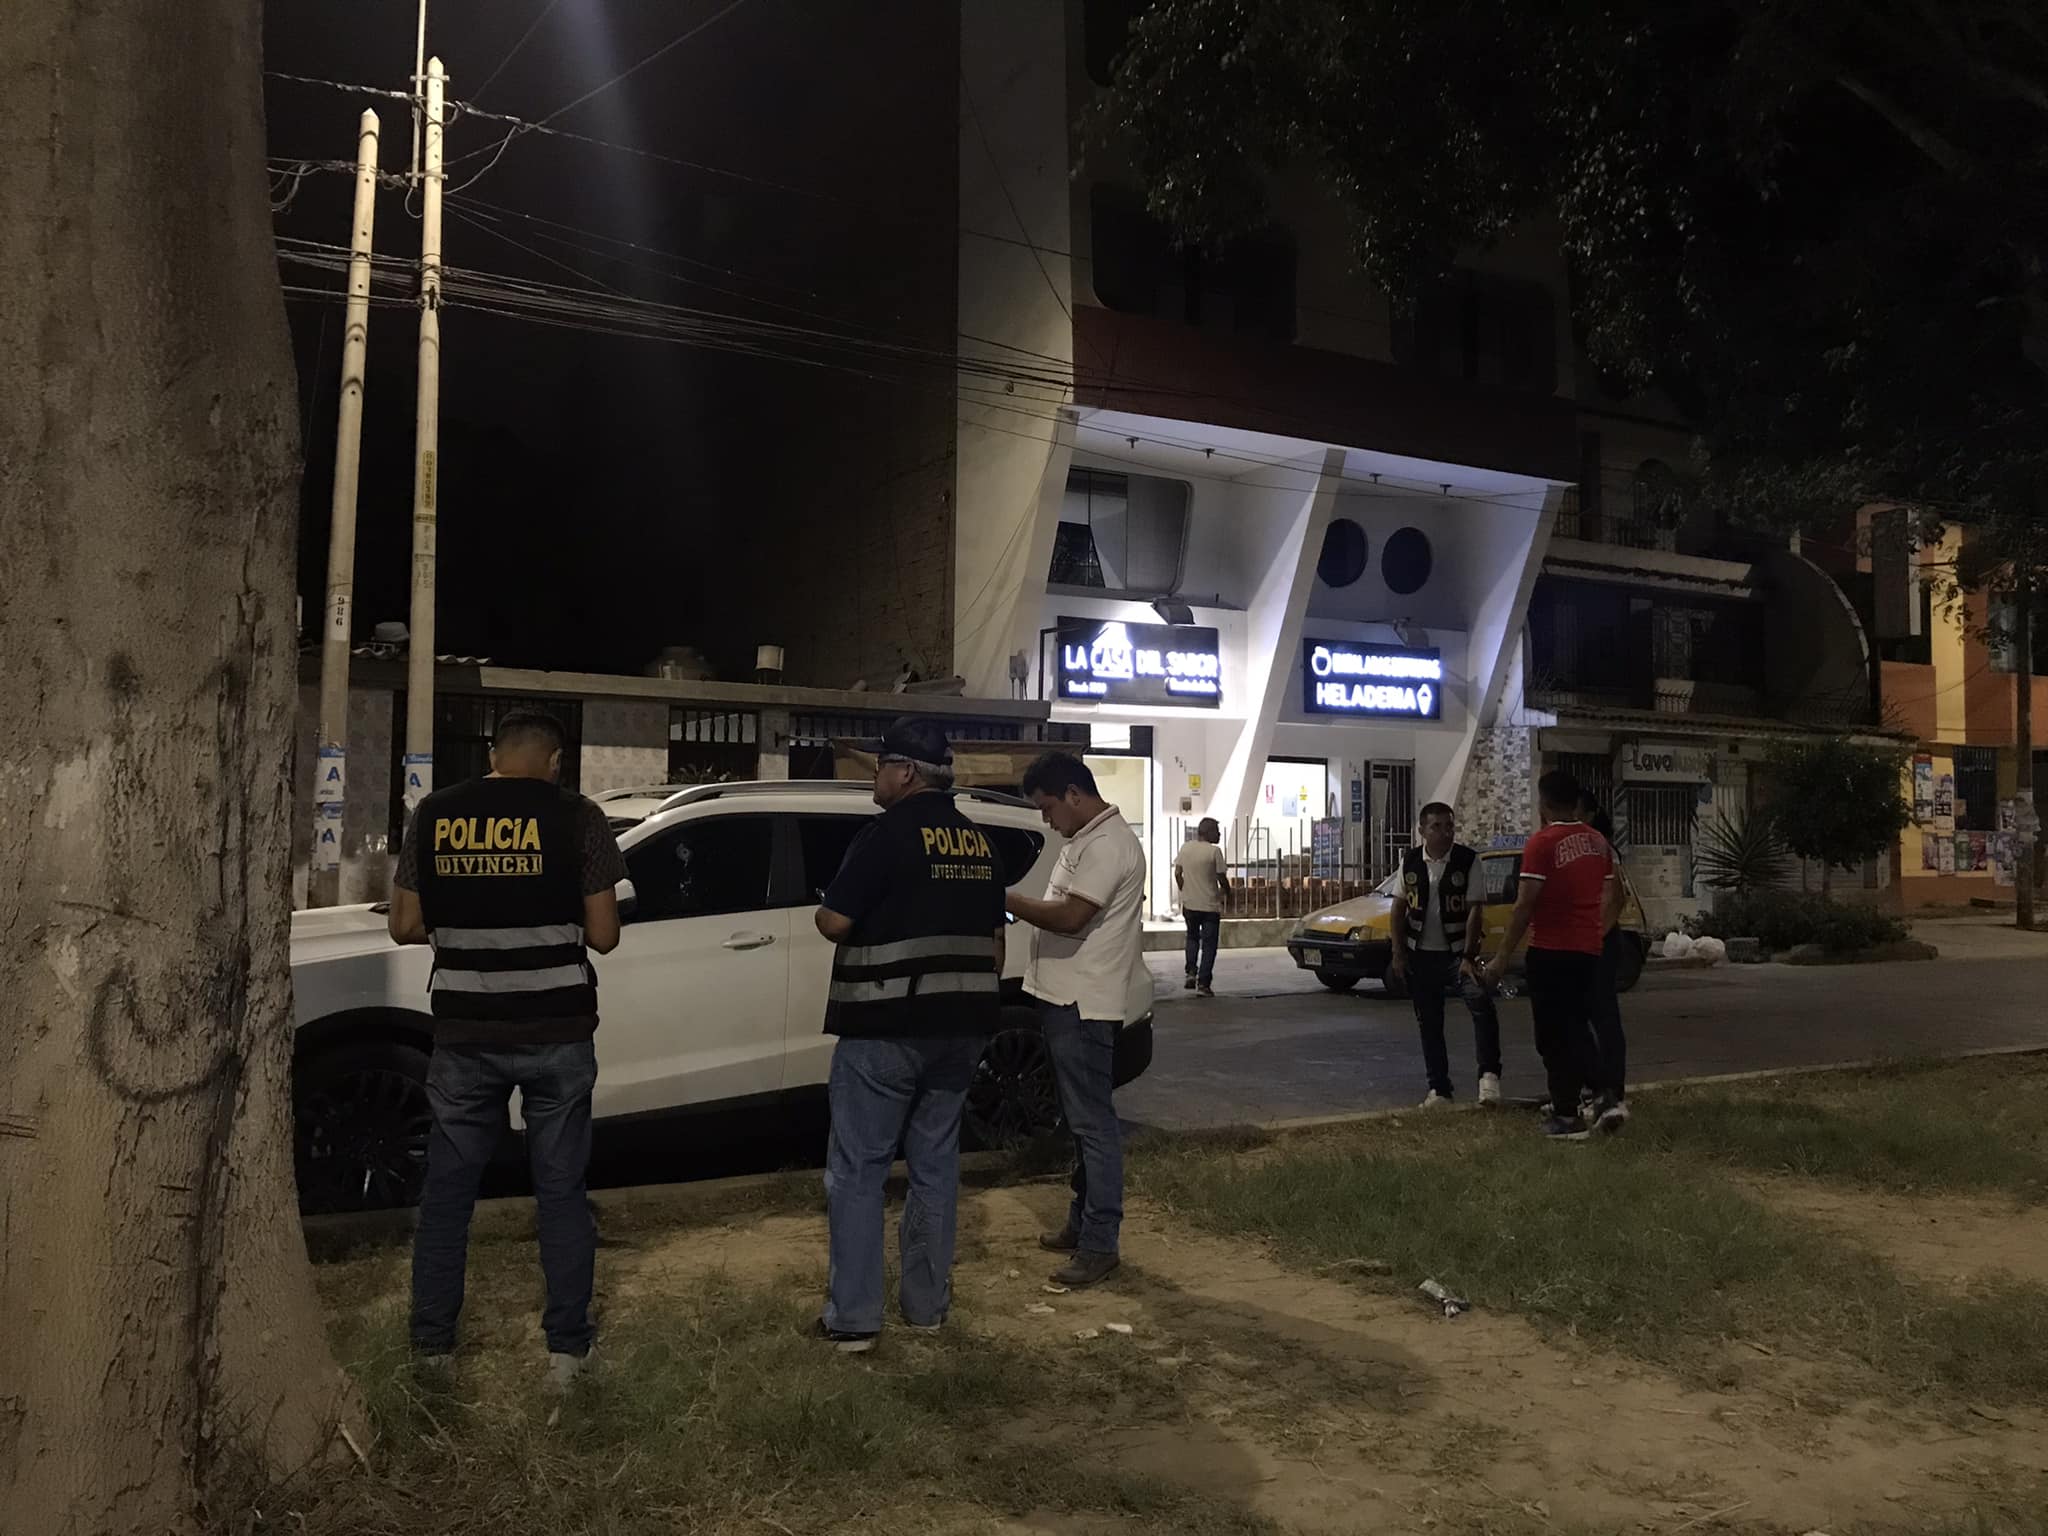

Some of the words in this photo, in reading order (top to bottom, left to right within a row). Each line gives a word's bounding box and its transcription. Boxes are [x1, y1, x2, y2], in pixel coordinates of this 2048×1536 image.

[1065, 644, 1088, 670] LA
[1090, 646, 1133, 673] CASA
[1316, 682, 1417, 710] HELADERIA
[326, 766, 341, 781] A
[409, 772, 422, 787] A
[322, 828, 336, 843] A
[920, 827, 992, 858] POLICIA
[439, 856, 540, 874] DIVINCRI
